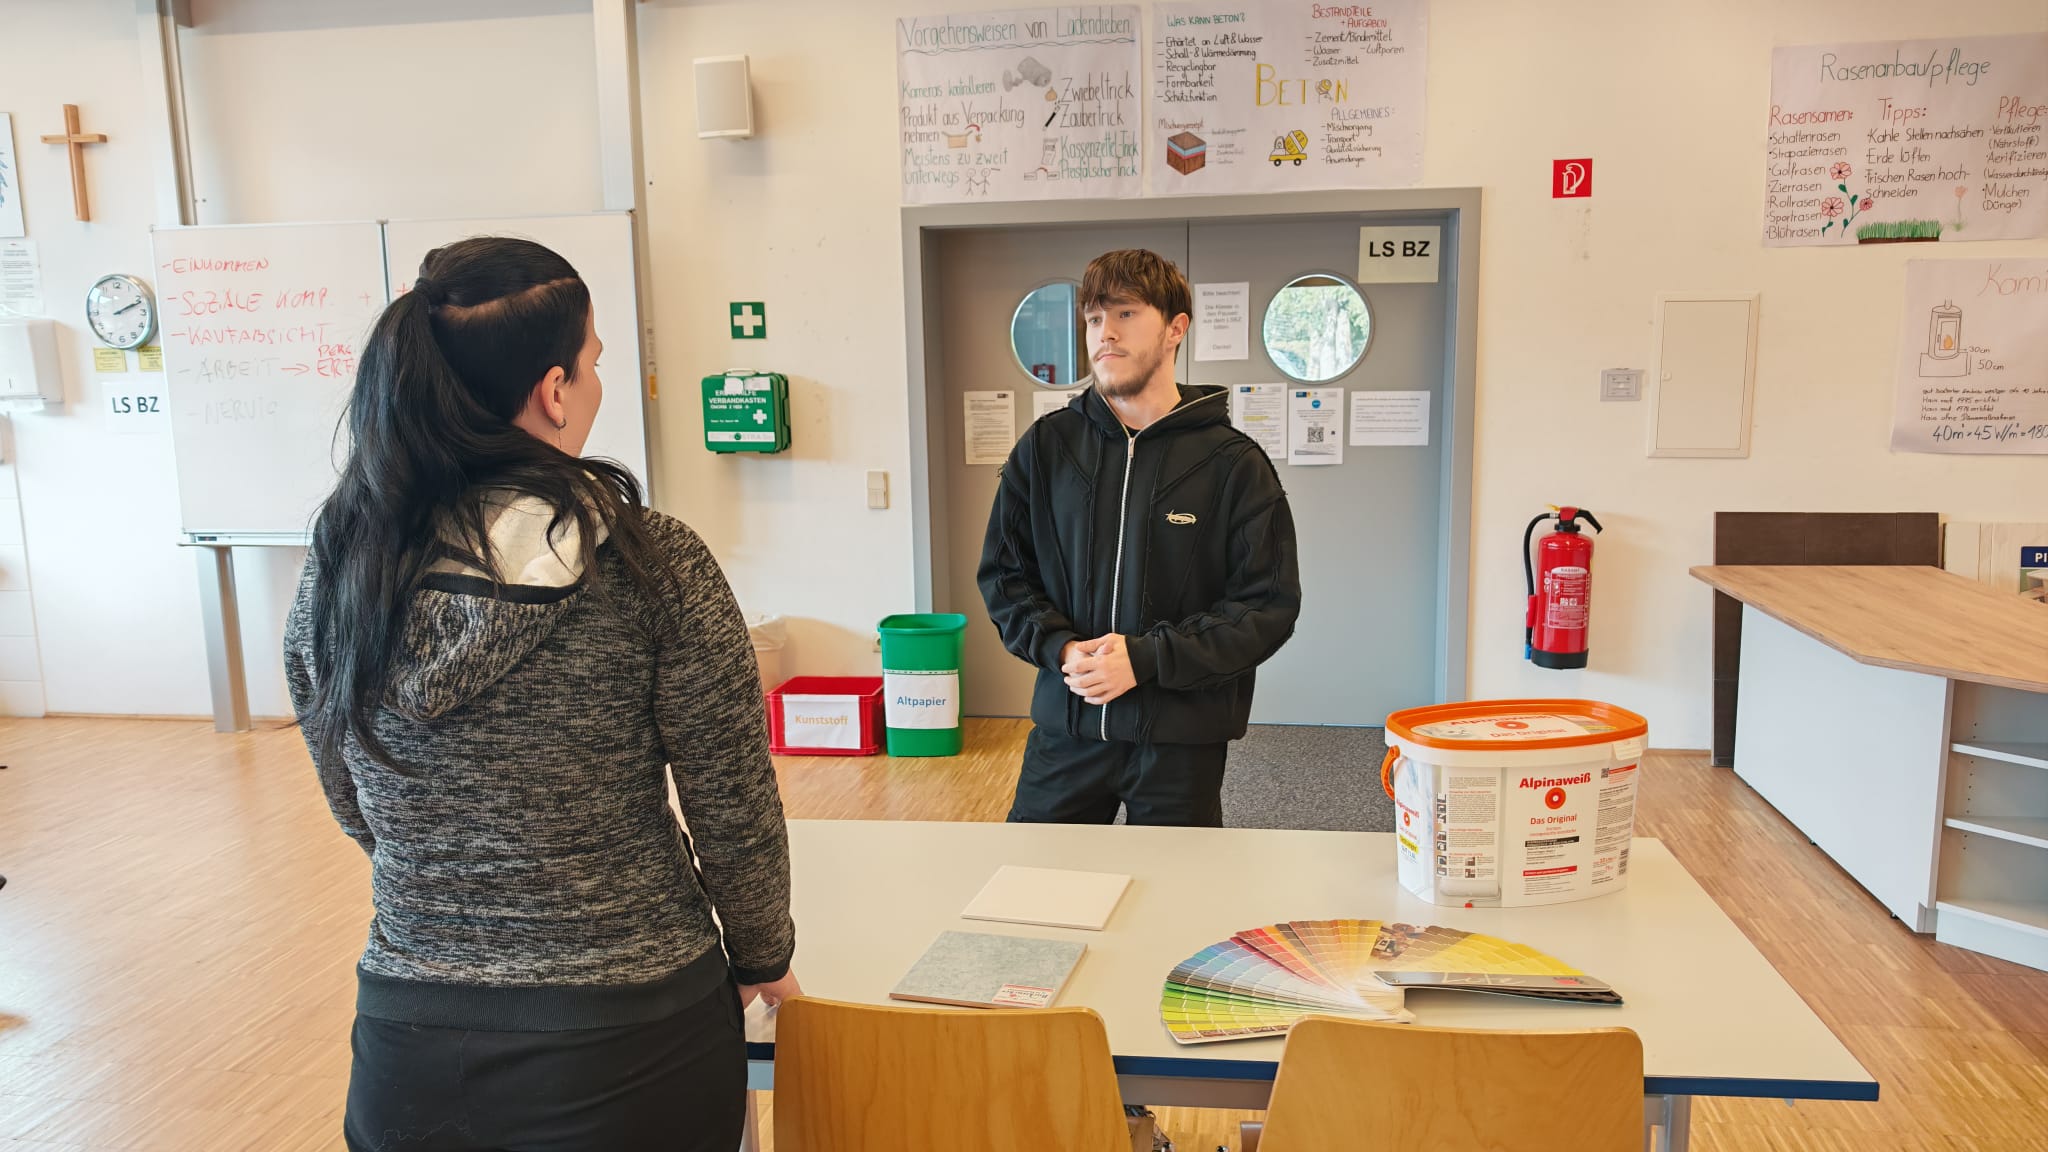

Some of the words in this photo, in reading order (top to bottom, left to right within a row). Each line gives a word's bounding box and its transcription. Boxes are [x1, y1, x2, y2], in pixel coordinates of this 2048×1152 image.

[1167, 15, 1186, 27] WAS
[1188, 16, 1211, 25] KANN
[1213, 11, 1246, 24] BETON?
[1312, 3, 1372, 19] BESTANDTEILE
[899, 16, 1017, 49] Vorgehensweisen
[1025, 21, 1047, 39] von
[1056, 7, 1130, 37] Ladendieben
[1347, 17, 1388, 28] AUFGABEN
[1201, 38, 1210, 46] an
[1313, 45, 1341, 55] Wasser
[1166, 60, 1217, 78] Recyclingbar
[1312, 56, 1360, 67] Zusatzmittel
[1820, 48, 1991, 88] Rasenanbau/pflege
[1061, 70, 1134, 102] Zwiebeltrick
[1166, 73, 1214, 88] Formbarkeit
[902, 80, 943, 99] Kameras
[1163, 89, 1217, 103] Schutzfunktion
[902, 103, 937, 127] Produkt
[942, 112, 960, 126] aus
[961, 96, 1025, 128] Verpackung
[1877, 97, 1927, 126] Tipps:
[904, 128, 940, 144] nehmen
[1906, 127, 1933, 141] Stellen
[904, 144, 950, 166] Meistens
[958, 152, 971, 166] zu
[975, 147, 1008, 166] zweit
[1867, 147, 1895, 164] Erde
[1771, 160, 1826, 179] Golfrasen
[1907, 168, 1936, 181] Rasen
[1770, 180, 1822, 193] Zierrasen
[1865, 184, 1918, 199] schneiden
[1984, 183, 2030, 199] Mulchen
[1769, 195, 1820, 209] Rollrasen
[1769, 210, 1822, 224] Sportrasen
[1768, 224, 1820, 240] Blührasen
[1369, 241, 1395, 258] LS
[1402, 240, 1430, 257] BZ
[112, 281, 121, 289] 12
[112, 397, 131, 414] LS
[137, 396, 160, 413] BZ
[896, 695, 946, 708] Altpapier
[795, 714, 849, 726] Kunststoff
[1519, 772, 1591, 790] Alpinaweiß
[1530, 817, 1545, 825] Das
[1547, 814, 1577, 824] Original
